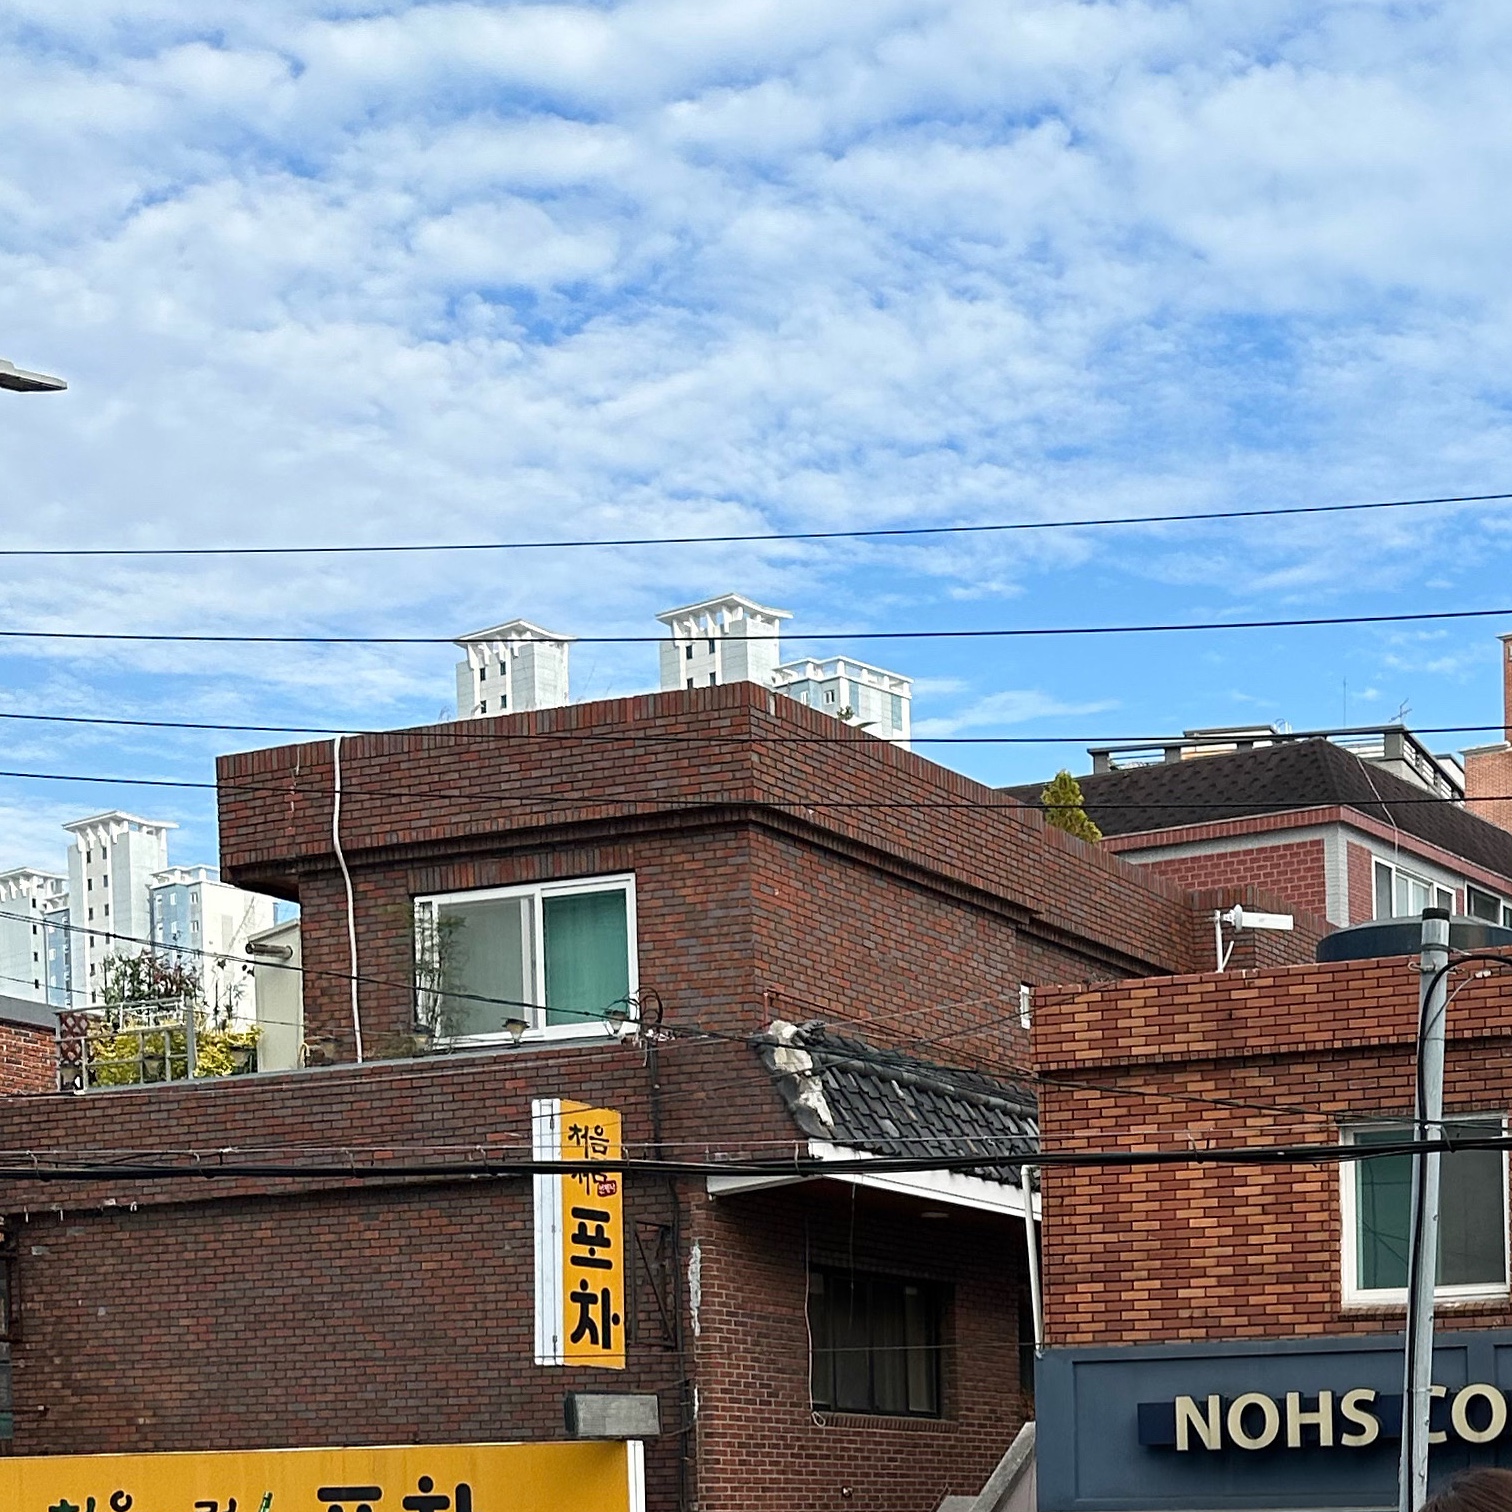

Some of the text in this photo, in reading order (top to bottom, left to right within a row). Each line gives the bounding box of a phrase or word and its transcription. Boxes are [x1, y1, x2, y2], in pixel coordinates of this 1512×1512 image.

[568, 1123, 610, 1159] 처음
[570, 1206, 621, 1350] 포차
[1175, 1387, 1382, 1452] NOHS
